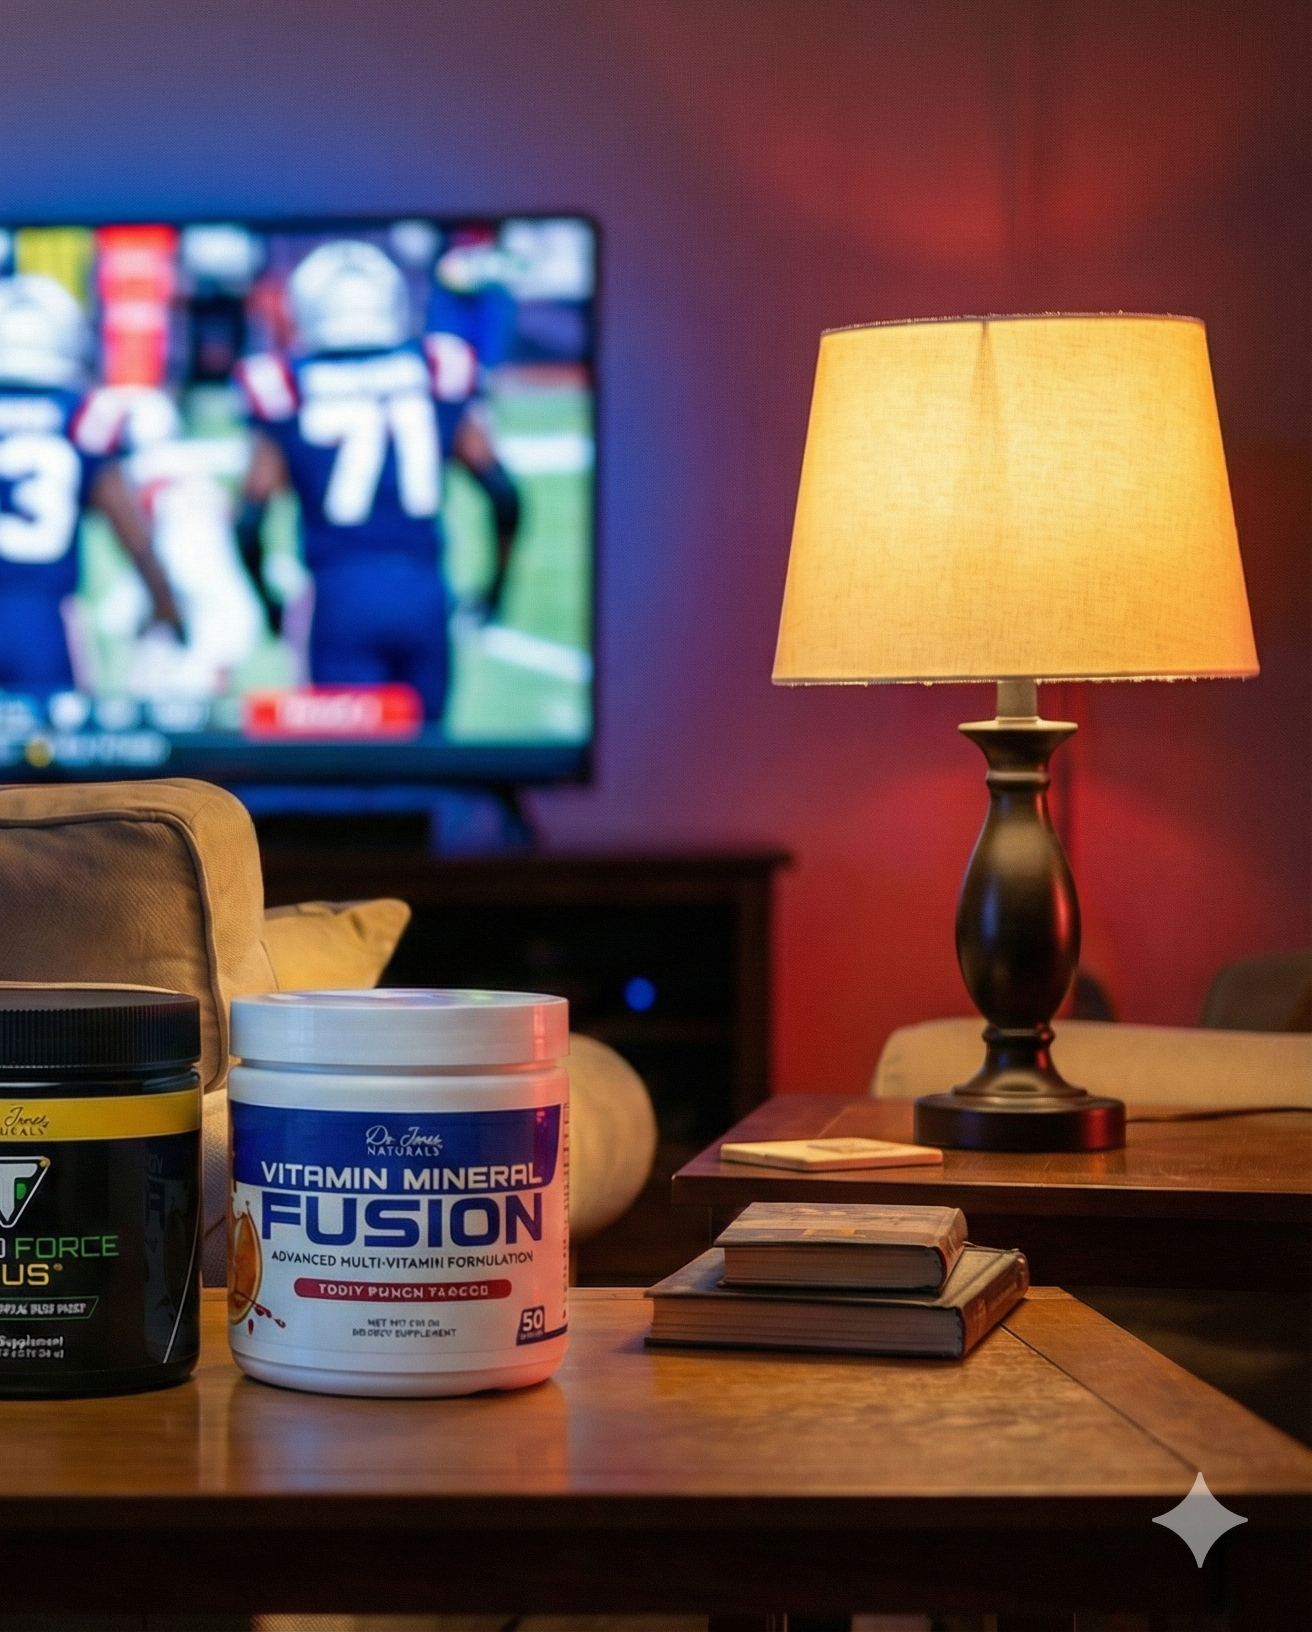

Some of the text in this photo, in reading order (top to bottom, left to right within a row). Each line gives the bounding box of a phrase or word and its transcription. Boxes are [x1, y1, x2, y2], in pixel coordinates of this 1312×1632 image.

[299, 393, 440, 527] 71
[368, 1146, 440, 1157] NATURALS
[261, 1161, 542, 1190] VITAMIN MINERAL
[261, 1191, 543, 1248] FUSION
[15, 1235, 119, 1259] FORCE
[271, 1250, 337, 1267] ADVANCED
[448, 1250, 534, 1269] FORMULATION
[522, 1309, 544, 1332] 50
